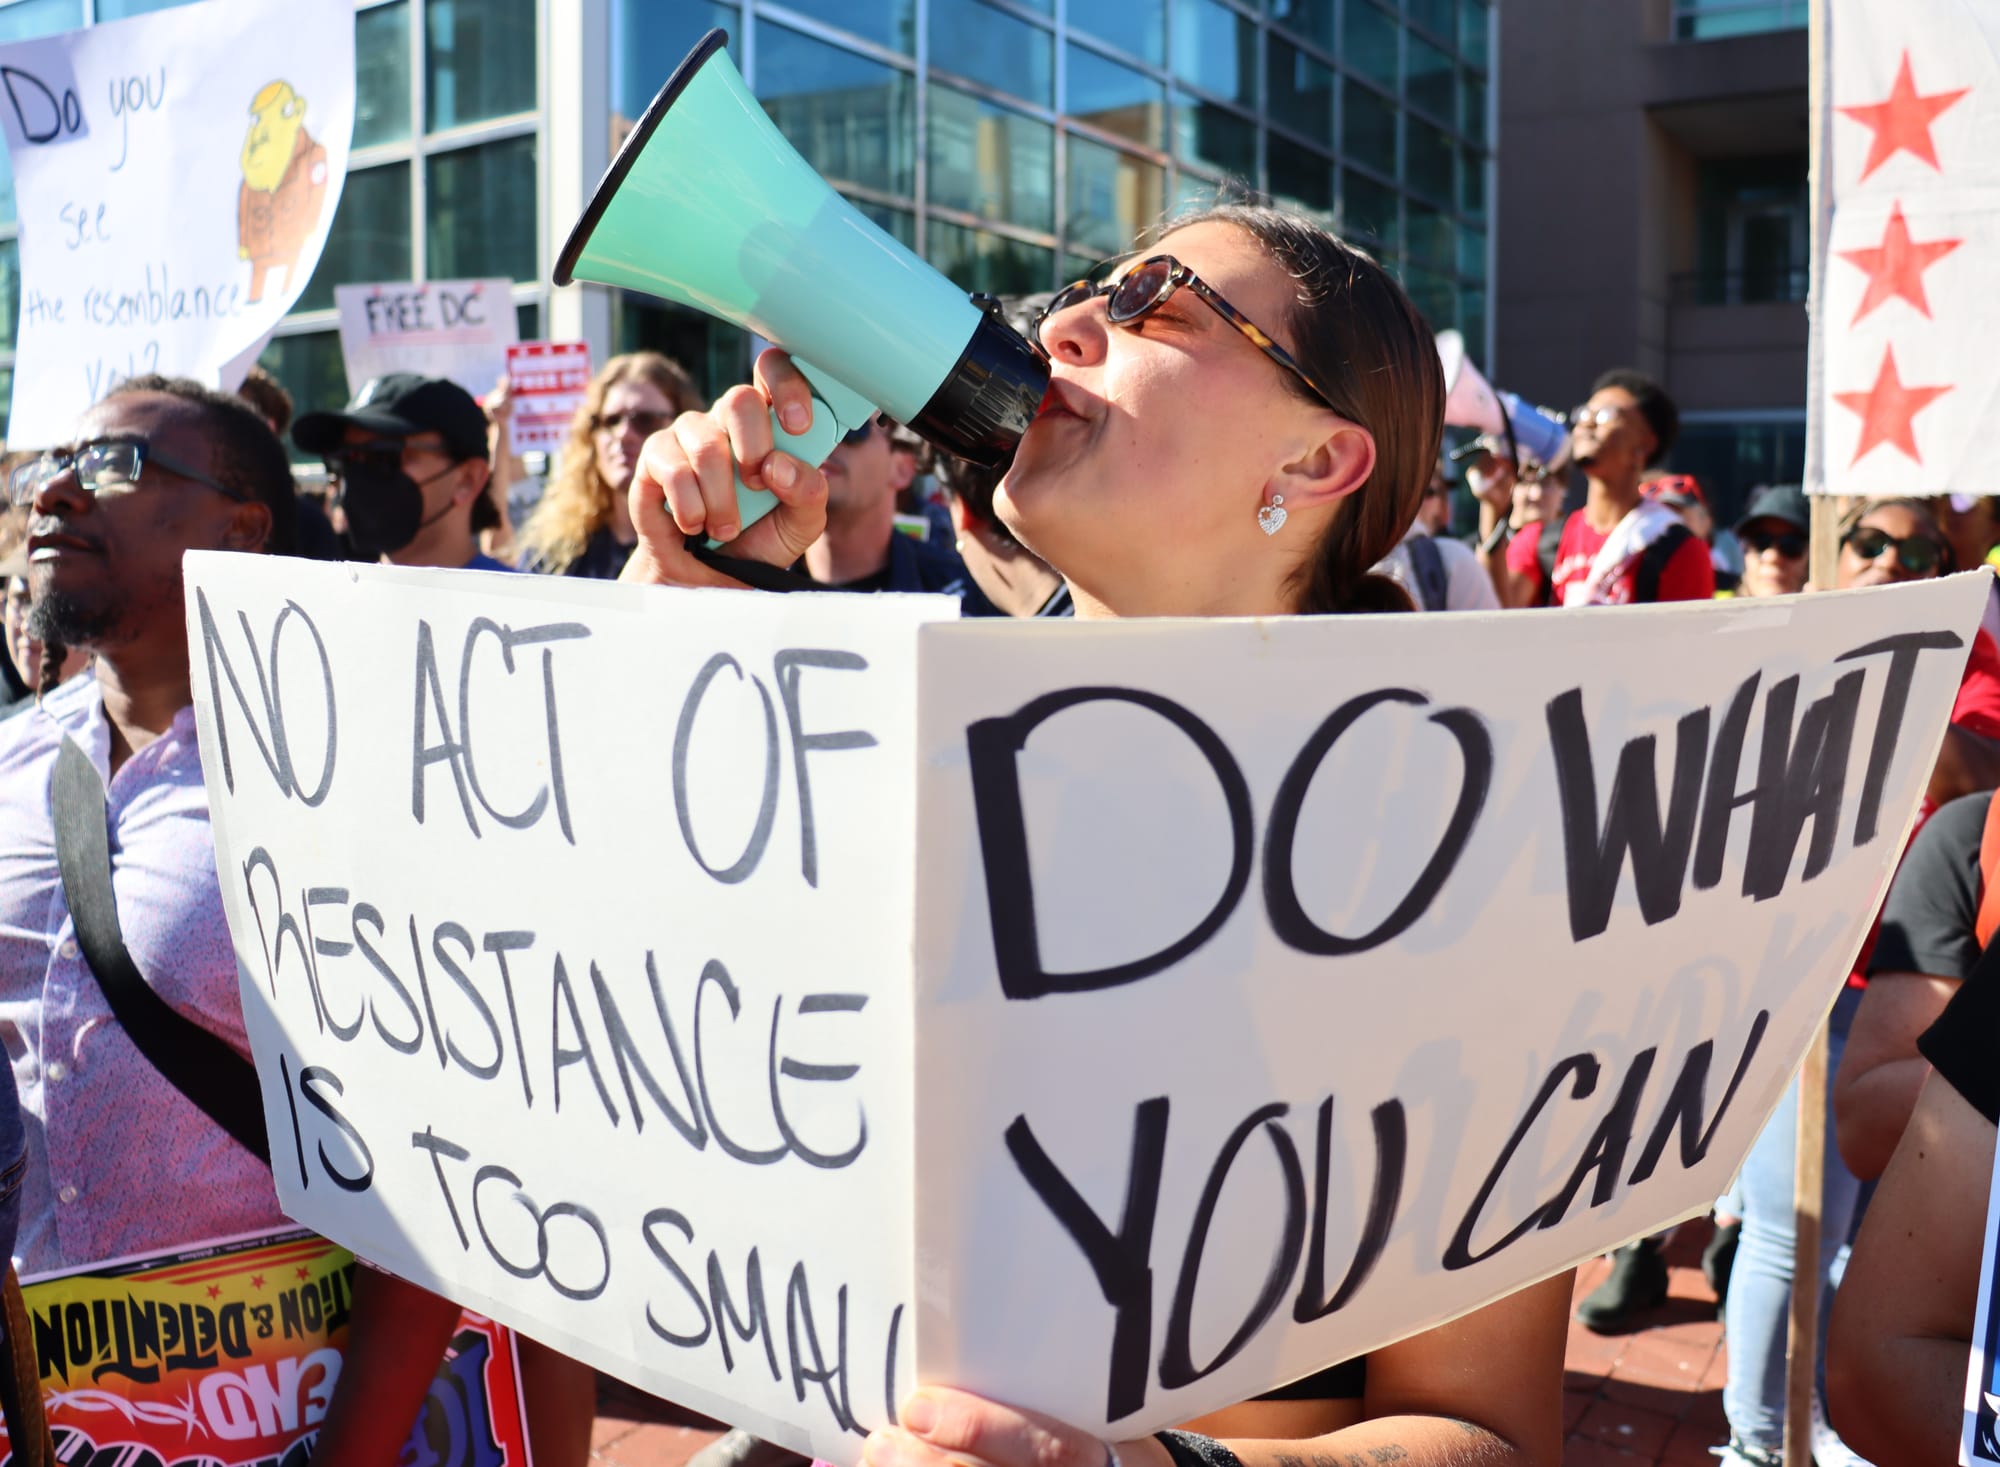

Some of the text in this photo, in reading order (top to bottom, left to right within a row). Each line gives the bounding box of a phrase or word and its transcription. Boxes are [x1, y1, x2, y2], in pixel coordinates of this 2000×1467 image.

[0, 64, 166, 173] Do you
[25, 262, 241, 327] the resemblance
[365, 290, 485, 334] FREE DC
[196, 586, 879, 888] NO ACT OF
[966, 630, 1965, 999] DO WHAT
[243, 845, 868, 1168] RESISTANCE
[280, 1053, 373, 1192] IS
[412, 1125, 610, 1300] TOO
[1004, 1009, 1769, 1424] YOU CAN
[199, 1346, 343, 1441] END
[249, 1304, 274, 1339] &
